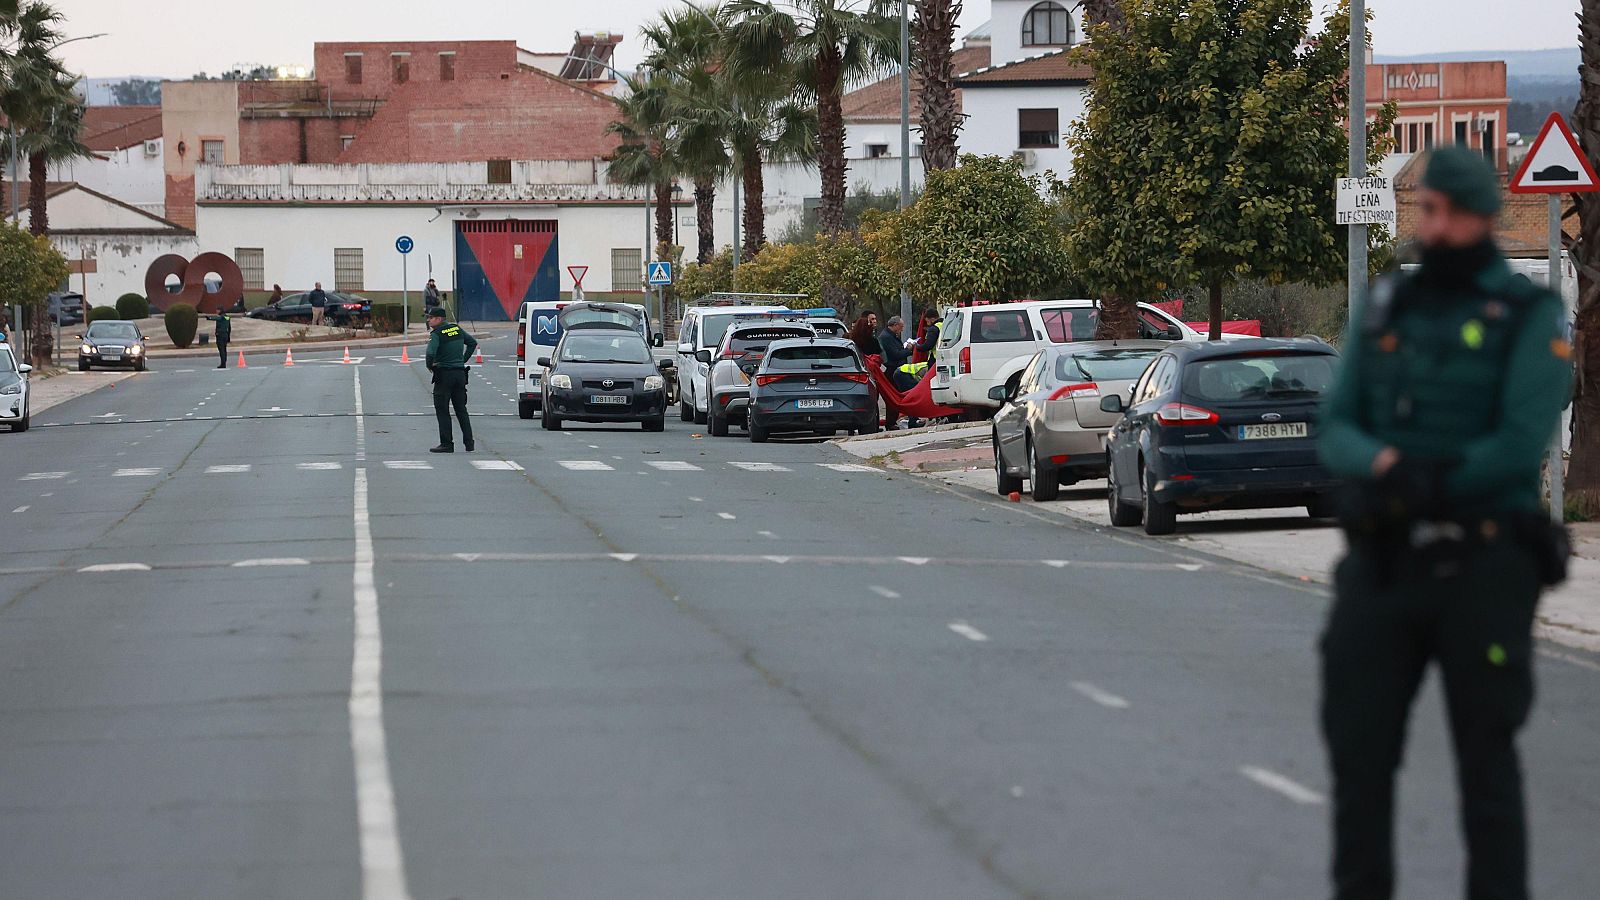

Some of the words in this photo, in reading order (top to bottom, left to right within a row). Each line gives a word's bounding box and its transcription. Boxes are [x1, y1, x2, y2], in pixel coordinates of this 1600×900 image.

[1357, 177, 1388, 190] VENDE
[1355, 191, 1380, 208] LEÑA
[815, 327, 833, 335] CIVIL
[1246, 425, 1277, 438] 7388
[1281, 423, 1304, 436] HTM
